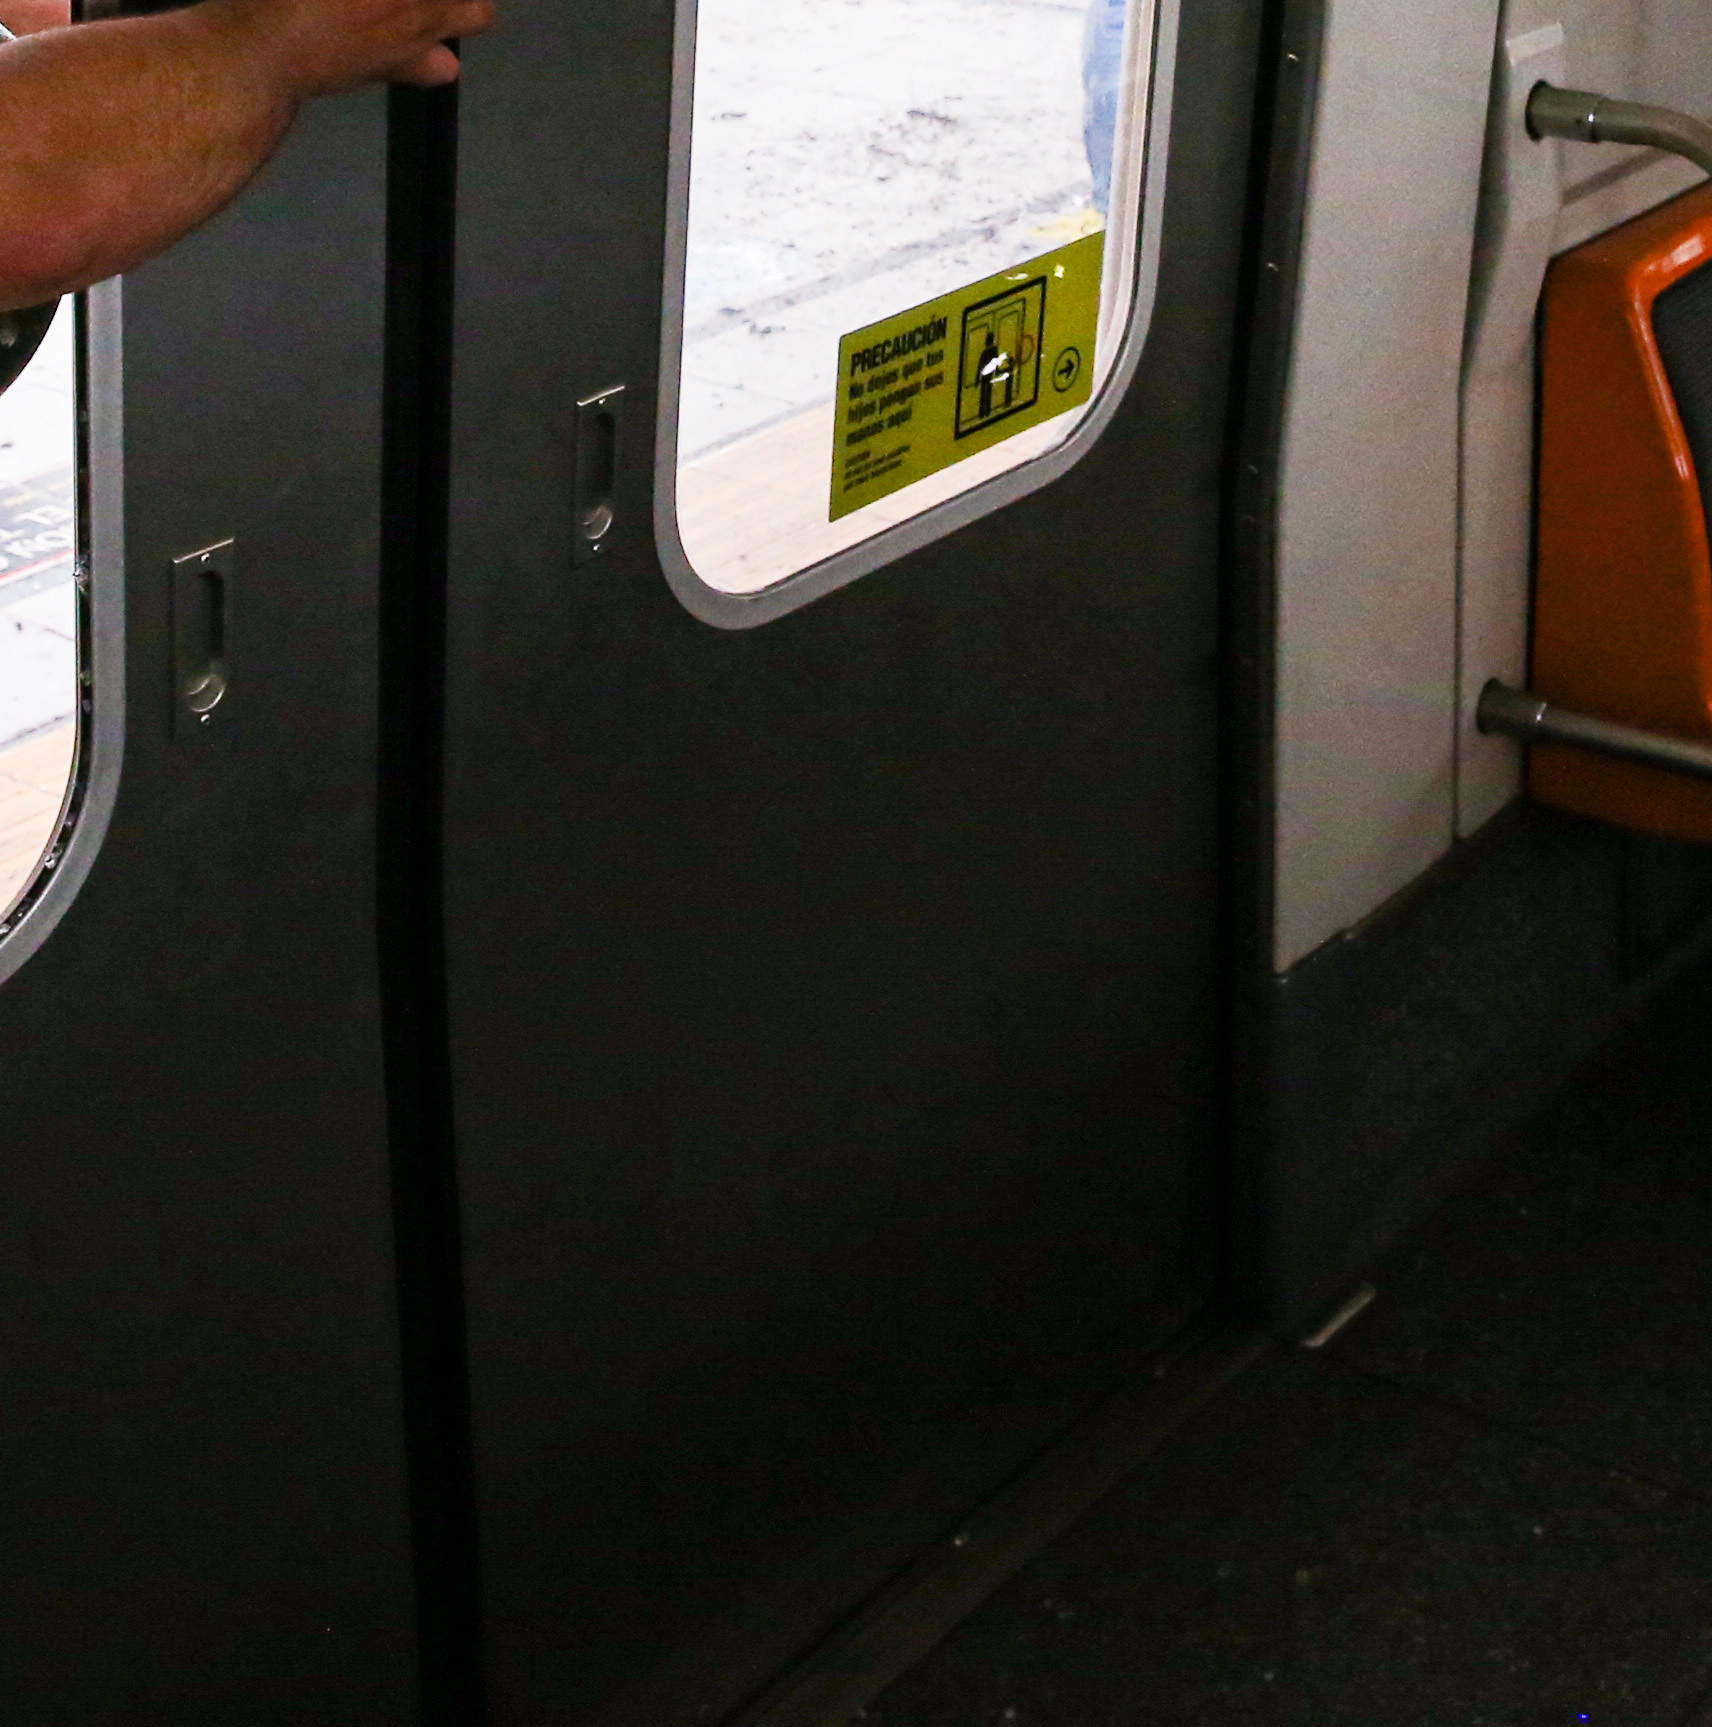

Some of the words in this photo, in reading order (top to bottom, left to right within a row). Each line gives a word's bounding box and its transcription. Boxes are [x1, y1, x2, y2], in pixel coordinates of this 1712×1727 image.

[850, 313, 948, 378] PRECAUCIÓN
[867, 368, 899, 393] dejes
[902, 358, 924, 380] que
[926, 349, 945, 367] tus
[847, 400, 877, 424] hijos
[925, 371, 945, 391] sus
